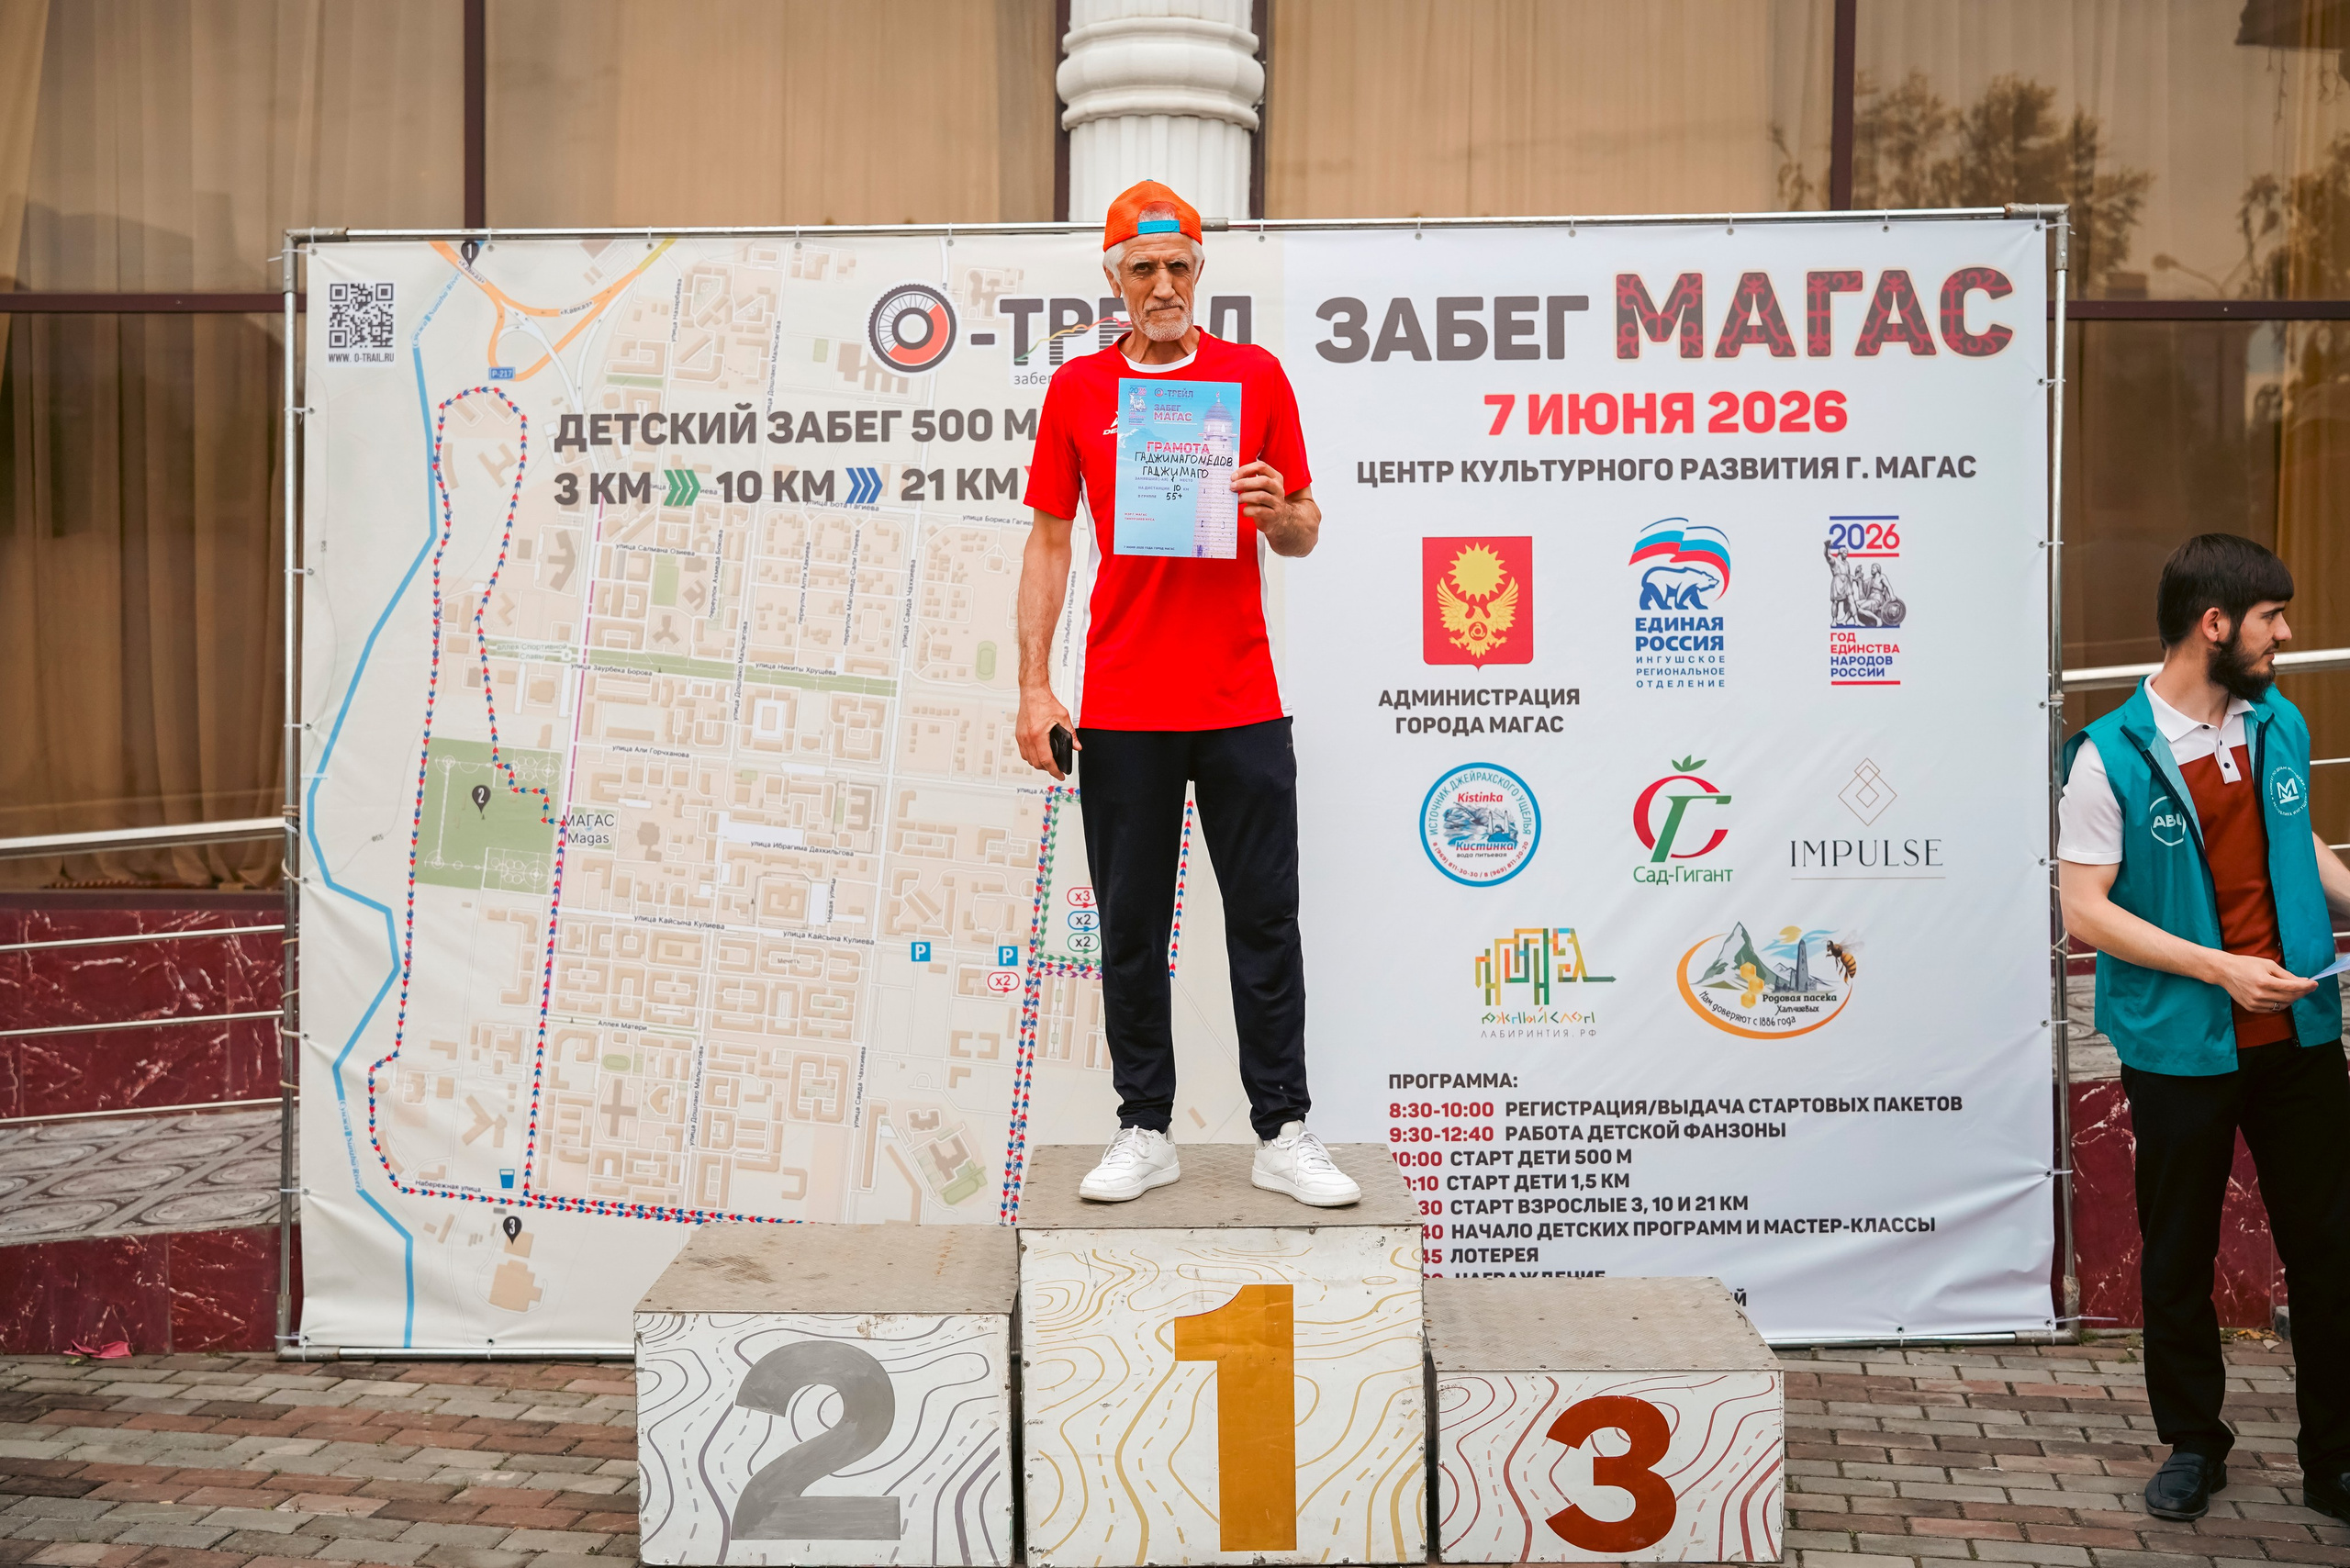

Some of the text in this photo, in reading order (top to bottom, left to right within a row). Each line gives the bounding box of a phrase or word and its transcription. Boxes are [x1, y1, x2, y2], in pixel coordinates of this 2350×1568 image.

[467, 244, 472, 258] 1
[1315, 267, 2015, 364] ЗАБЕГ МАГАС
[1154, 412, 1192, 421] МАГАС
[1484, 389, 1848, 435] 7 ИЮНЯ 2026
[554, 402, 1037, 453] ДЕТСКИЙ ЗАБЕГ 500 М
[1147, 442, 1210, 454] ГРАМОТА
[1135, 452, 1233, 466] ГАДЖИМАГОМЕДОВ
[1357, 454, 1976, 487] ЦЕНТР КУЛЬТУРНОГО РАЗВИТИЯ Г. МАГАС
[554, 468, 1018, 505] 3 КМ 10 КМ 21 КМ
[1167, 492, 1182, 500] 55+
[1012, 517, 1035, 526] Гагие
[1830, 523, 1900, 550] 2026
[616, 543, 695, 556] улица Салмана Озиева
[1636, 617, 1724, 633] ЕДИНАЯ
[1636, 635, 1724, 652] РОССИЯ
[1830, 633, 1856, 644] ГОД
[1830, 644, 1900, 655] ЕДИНСТВА
[1636, 655, 1725, 665] ИНГУШСКОЕ
[1830, 656, 1893, 667] НАРОДОВ
[1636, 667, 1725, 676] РЕГИОНАЛЬНОЕ
[1830, 667, 1885, 678] РОССИИ
[1636, 679, 1725, 689] ОТДЕЛЕНИЕ
[1378, 688, 1580, 709] АДМИНИСТРАЦИЯ
[1395, 715, 1564, 737] ГОРОДА МАГАС
[478, 788, 485, 803] 2
[1428, 770, 1532, 836] ИСТОЧНИК ДЖЕЙРАХСКОГО УЩЕЛЬЯ
[1458, 791, 1503, 802] Kistinka
[564, 814, 615, 826] МАГАС
[568, 834, 610, 846] Magas
[1456, 841, 1514, 851] Кистинка
[1791, 838, 1943, 868] IMPULSE
[1633, 866, 1733, 885] Сад-Гигант
[1075, 890, 1090, 902] x3
[1076, 914, 1091, 925] x2
[1076, 936, 1091, 947] x2
[995, 975, 1011, 986] x2
[1762, 994, 1801, 1004] Родовая
[1699, 991, 1712, 1006] Нам
[1712, 1002, 1751, 1025] доверяют
[1759, 1017, 1775, 1026] 1886
[1778, 1016, 1796, 1026] года
[1389, 1073, 1517, 1089] ПРОГРАММА:
[1389, 1096, 1963, 1118] 8:30-10:00 РЕГИСТРАЦИЯ/ВЫДАЧА СТАРТОВЫХ ПАКЕТОВ
[1389, 1120, 1786, 1143] 9:30-12:40 РАБОТА ДЕТСКОЙ ФАНЗОНЫ
[1450, 1150, 1514, 1166] СТАРТ
[1518, 1149, 1570, 1168] ДЕТИ
[1575, 1149, 1612, 1164] 500
[1617, 1148, 1632, 1164] М
[1447, 1175, 1510, 1191] СТАРТ
[1514, 1174, 1567, 1192] ДЕТИ
[1571, 1173, 1596, 1191] 1,5
[1601, 1173, 1629, 1189] КМ
[1450, 1199, 1514, 1215] СТАРТ
[1518, 1197, 1627, 1214] ВЗРОСЛЫЕ
[1631, 1197, 1648, 1214] 3,
[1652, 1197, 1673, 1212] 10
[1678, 1196, 1691, 1211] И
[1695, 1196, 1716, 1211] 21
[1720, 1195, 1749, 1210] КМ
[509, 1218, 516, 1235] 3
[1451, 1223, 1532, 1239] НАЧАЛО
[1537, 1222, 1628, 1240] ДЕТСКИХ
[1634, 1220, 1741, 1236] ПРОГРАММ
[1747, 1220, 1759, 1234] И
[1763, 1217, 1936, 1234] МАСТЕР-КЛАССЫ
[1450, 1247, 1539, 1263] ЛОТЕРЕЯ
[1174, 1284, 1297, 1551] 1
[734, 1341, 901, 1540] 2
[1545, 1395, 1676, 1552] 3
